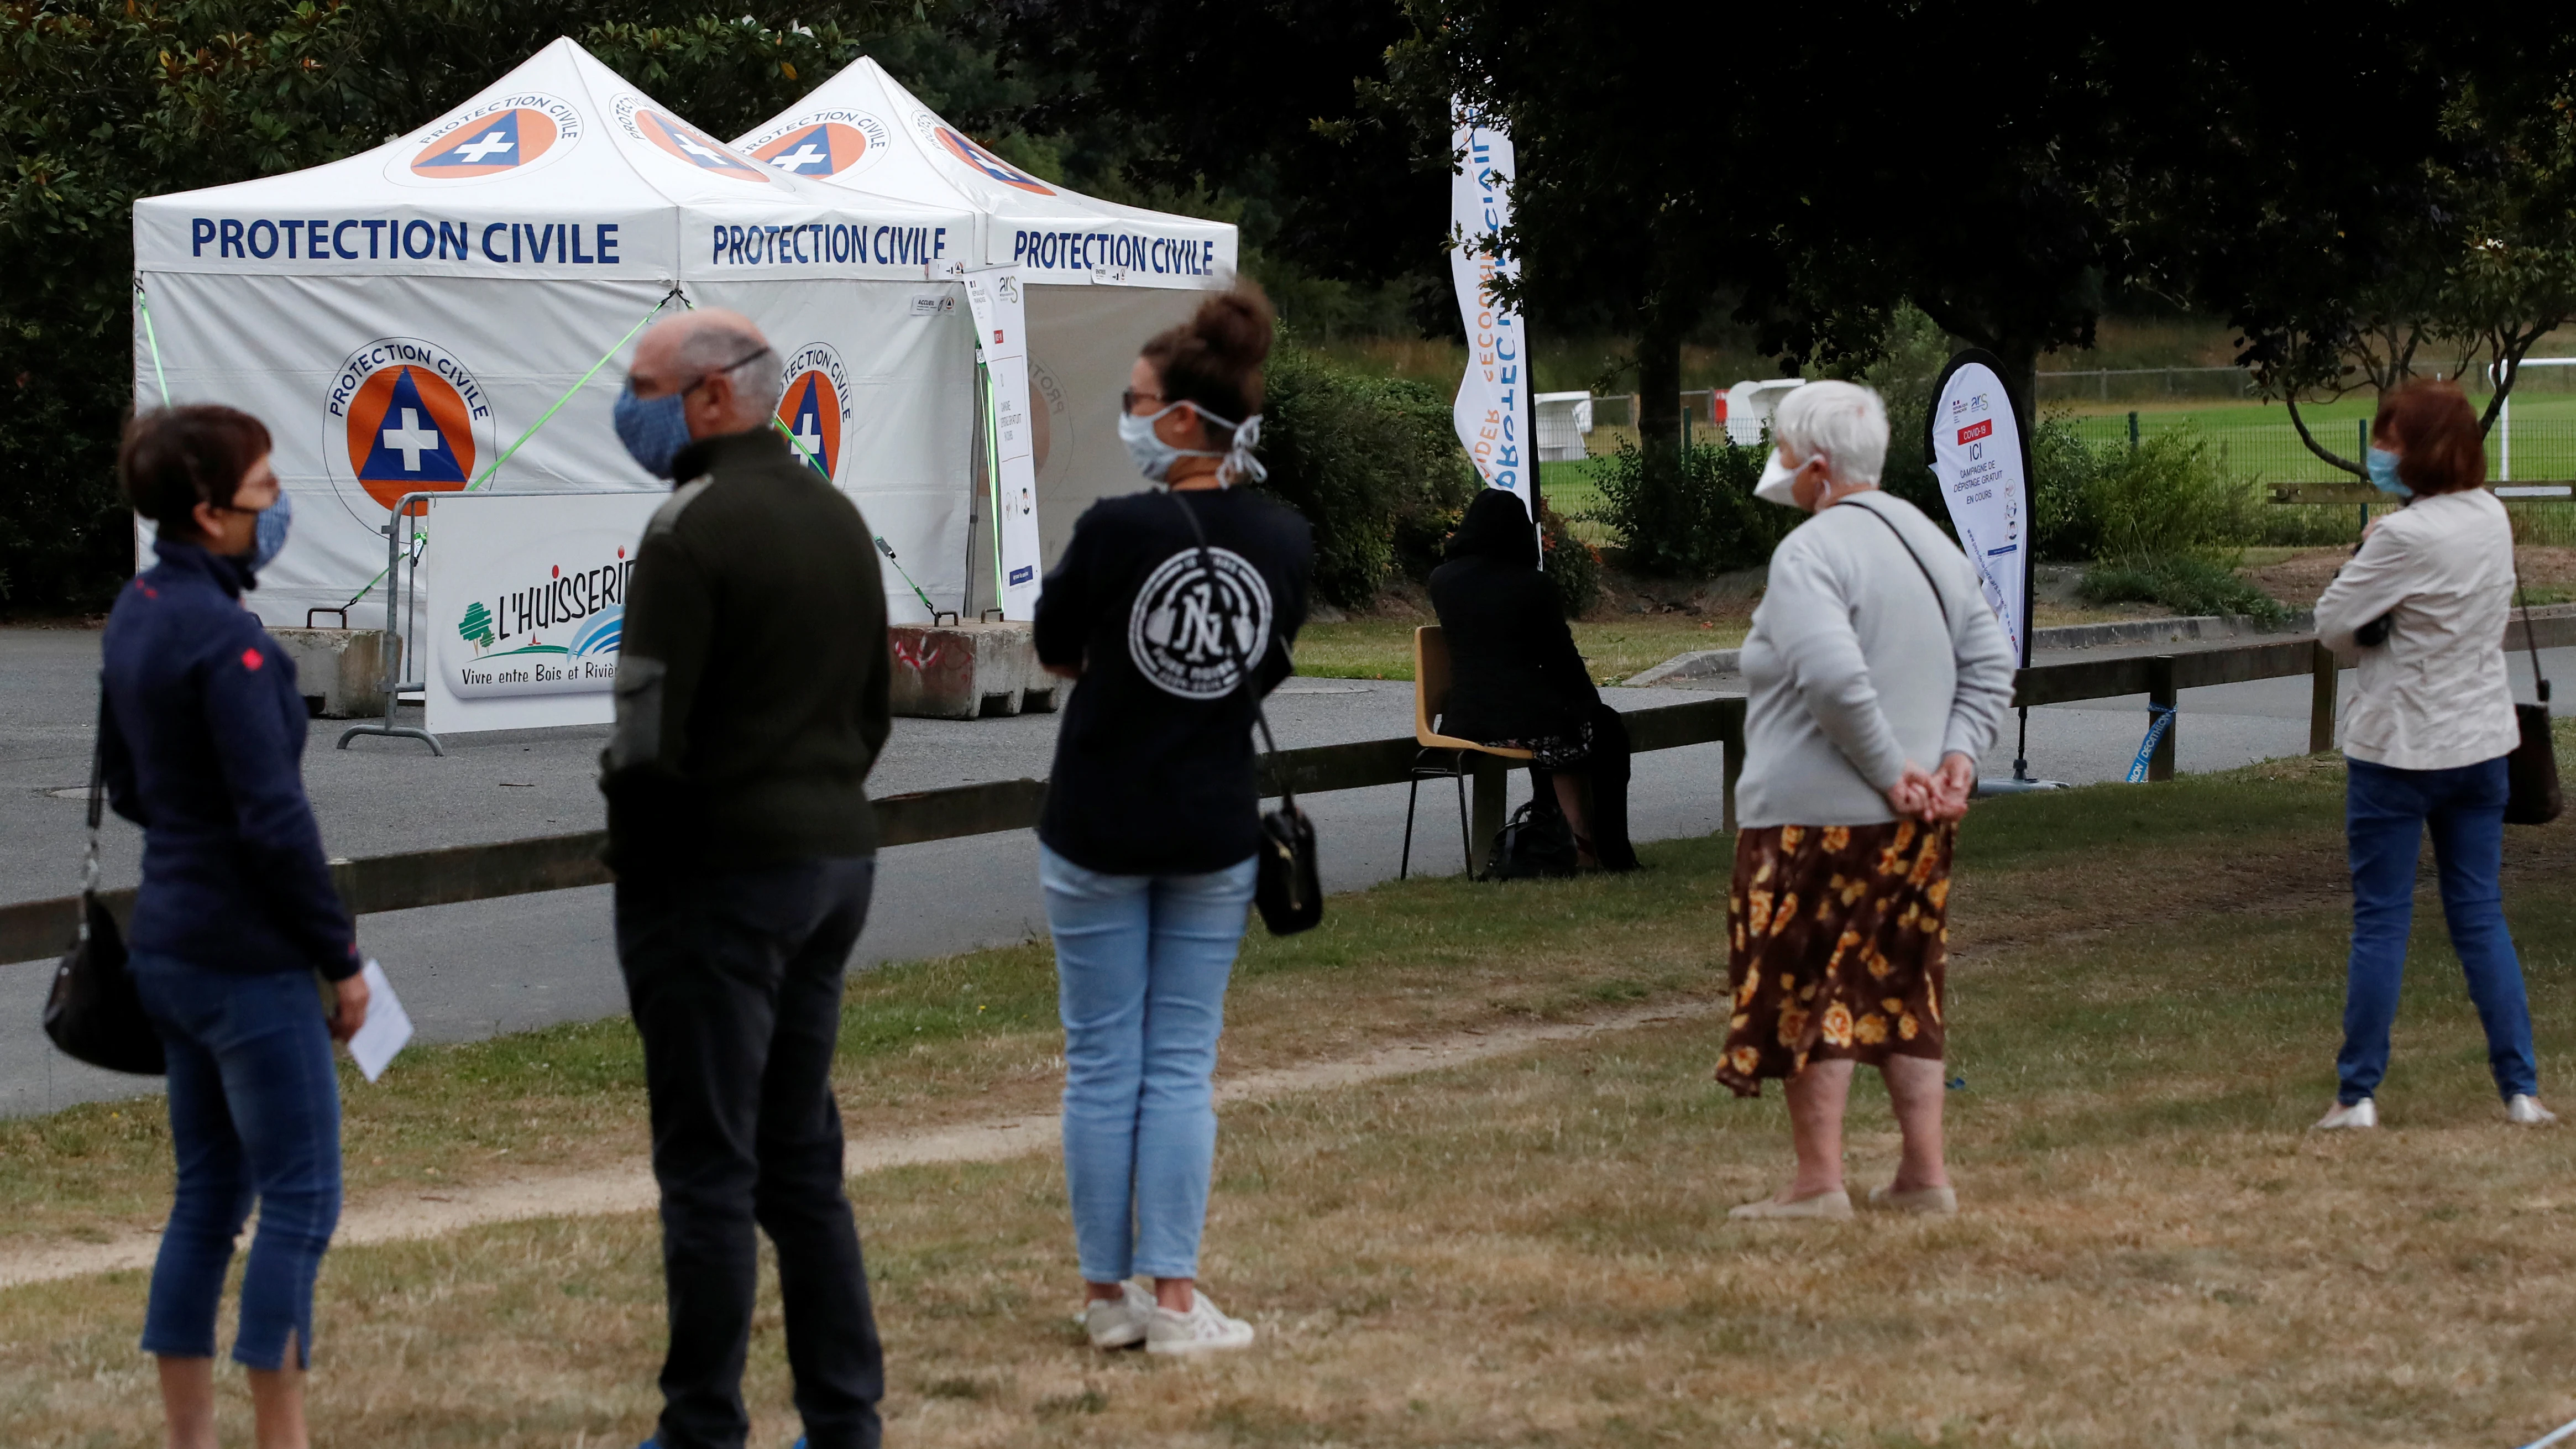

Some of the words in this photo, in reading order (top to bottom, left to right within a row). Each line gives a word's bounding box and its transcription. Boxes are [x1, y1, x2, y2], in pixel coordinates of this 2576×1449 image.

[418, 96, 551, 145] PROTECTION
[549, 104, 578, 139] CIVILE
[857, 118, 886, 149] CIVILE
[192, 218, 468, 260] PROTECTION
[482, 222, 620, 264] CIVILE
[713, 223, 868, 265] PROTECTION
[873, 226, 946, 265] CIVILE
[1014, 231, 1147, 272] PROTECTION
[1151, 237, 1213, 276] CIVILE
[329, 344, 432, 417] PROTECTION
[437, 358, 489, 421] CIVILE
[831, 362, 851, 423] CIVILE
[1963, 425, 1986, 441] COVID-19
[1960, 463, 1987, 479] CAMPAGNE
[1988, 460, 1996, 470] DE
[1970, 442, 1982, 462] ICI
[1954, 477, 1980, 493] DÉPISTAGE
[1982, 470, 2003, 484] GRATUIT
[1966, 495, 1974, 505] EN
[1975, 489, 1992, 502] COURS
[462, 668, 493, 685] Vivre
[499, 668, 529, 684] entre
[536, 663, 562, 682] Bois
[568, 666, 579, 680] et
[2140, 712, 2172, 758] DECATHLON
